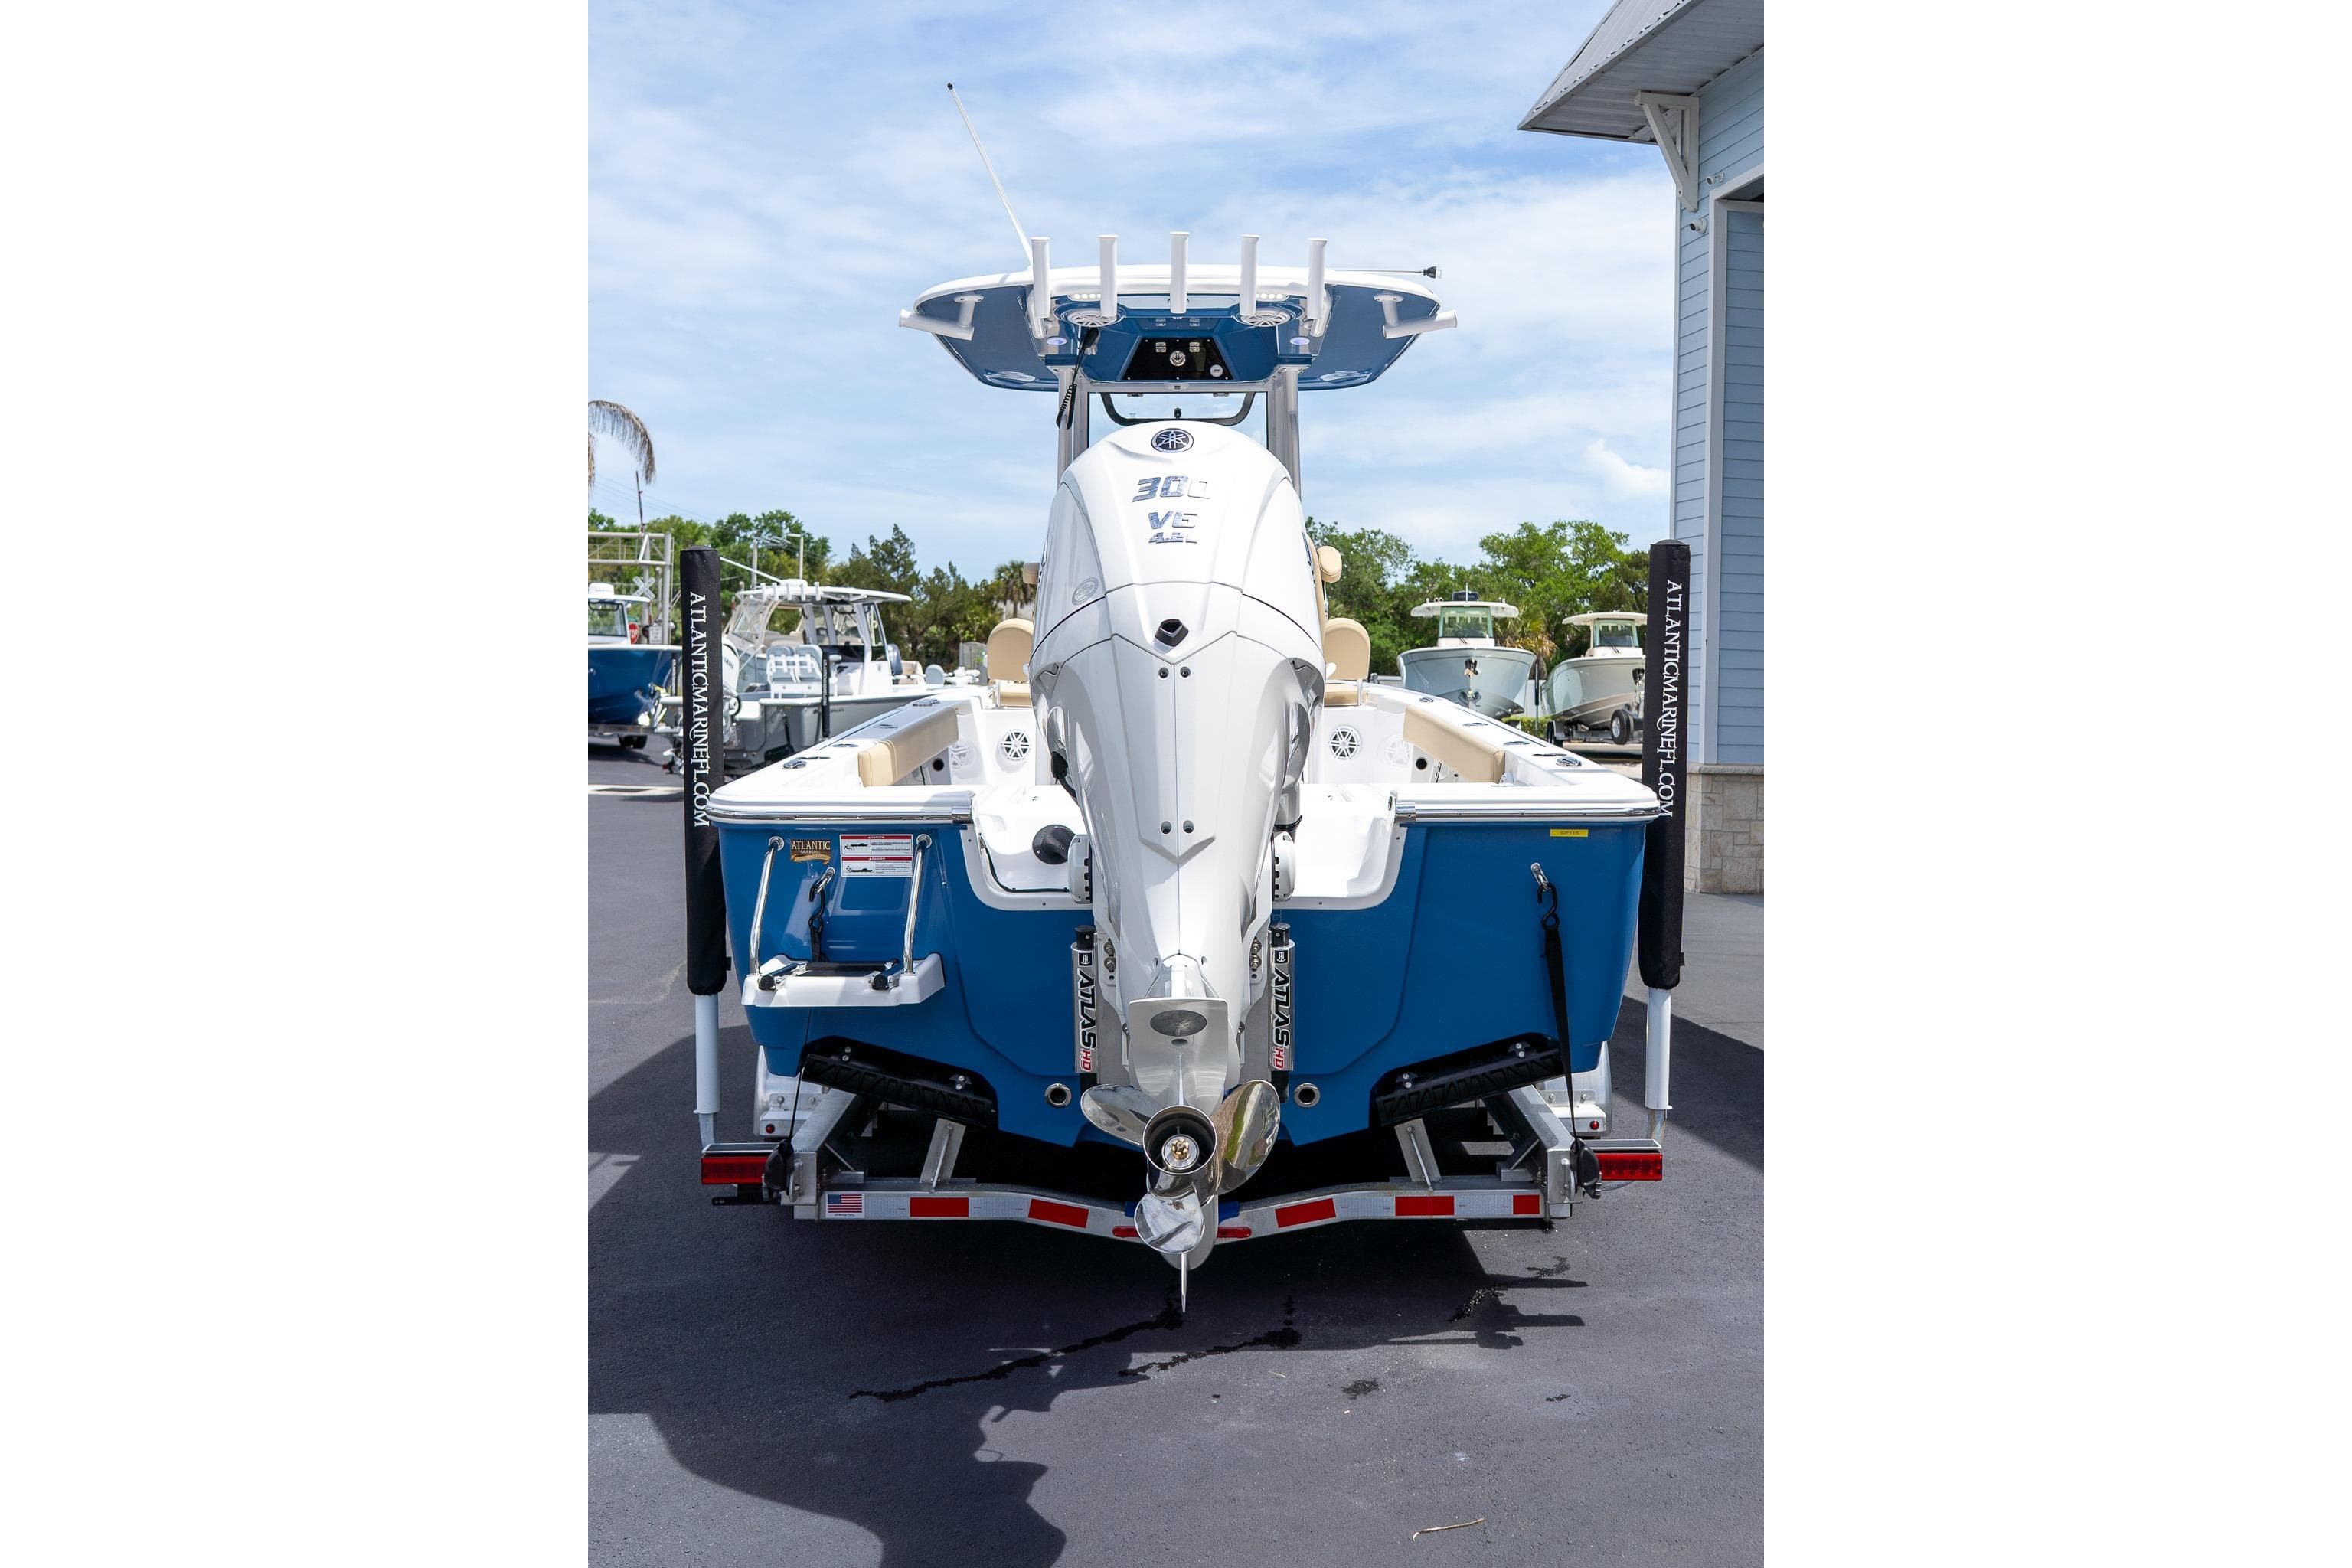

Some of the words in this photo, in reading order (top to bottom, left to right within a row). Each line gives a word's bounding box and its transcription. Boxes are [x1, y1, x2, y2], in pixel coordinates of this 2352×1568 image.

[1132, 476, 1212, 502] 300
[689, 591, 710, 828] ATLANTICMARINEFL.COM
[1656, 579, 1683, 817] ATLANTICMARINEFL.COM
[791, 841, 831, 850] ATLANTIC
[1077, 968, 1097, 1050] ATLAS
[1272, 965, 1291, 1048] ATLAS
[1080, 1048, 1092, 1072] HD
[1272, 1046, 1285, 1070] HD
